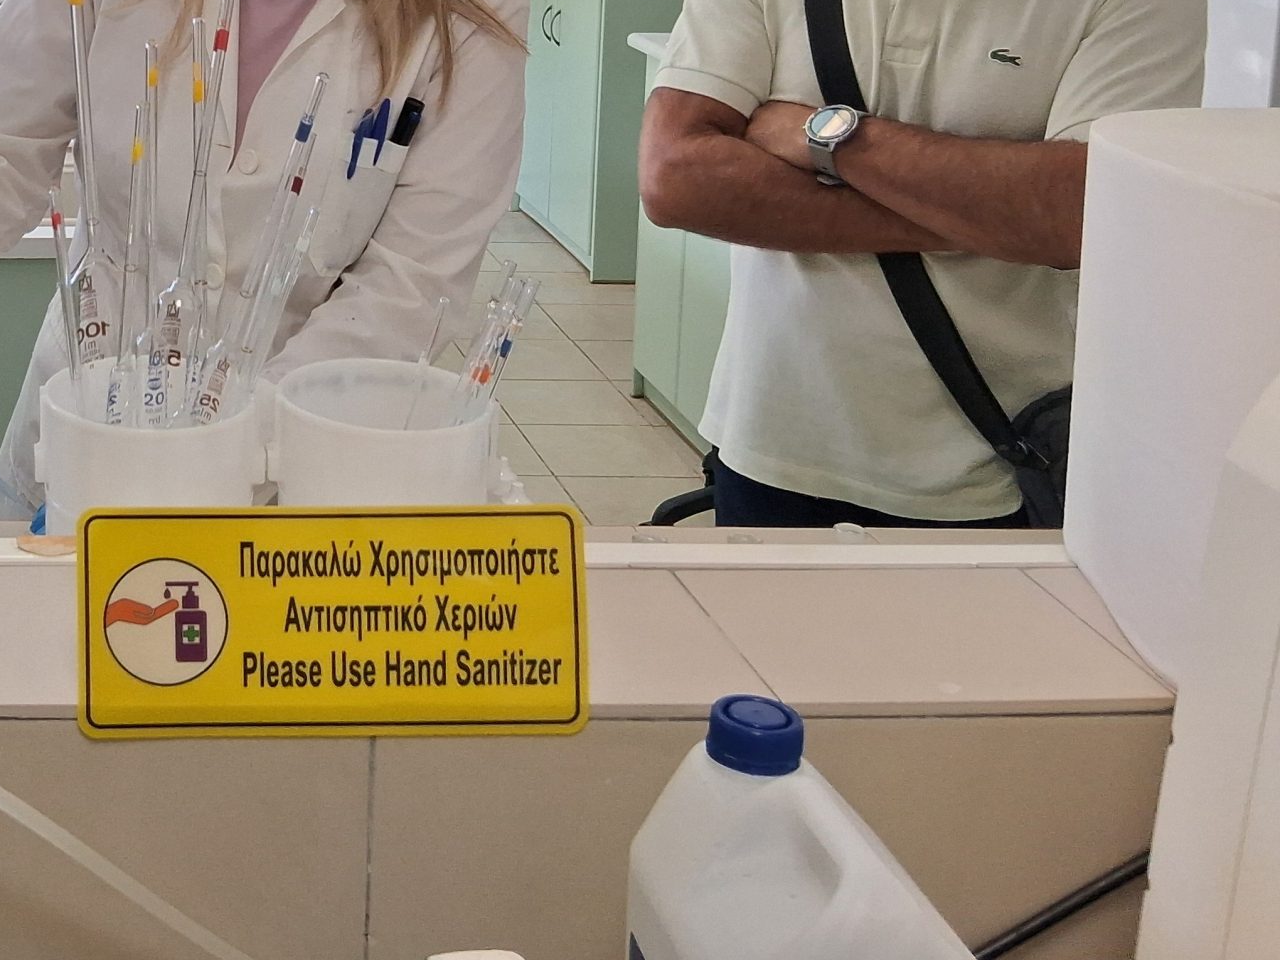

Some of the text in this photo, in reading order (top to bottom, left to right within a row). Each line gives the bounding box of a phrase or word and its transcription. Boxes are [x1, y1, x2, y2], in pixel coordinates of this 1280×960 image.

[144, 391, 165, 406] 20
[239, 540, 560, 588] Παρακαλώ Χρησιμοποιήστε
[284, 595, 517, 642] Αντισηπτικό Χεριών
[242, 649, 562, 688] Please Use Hand Sanitizer
